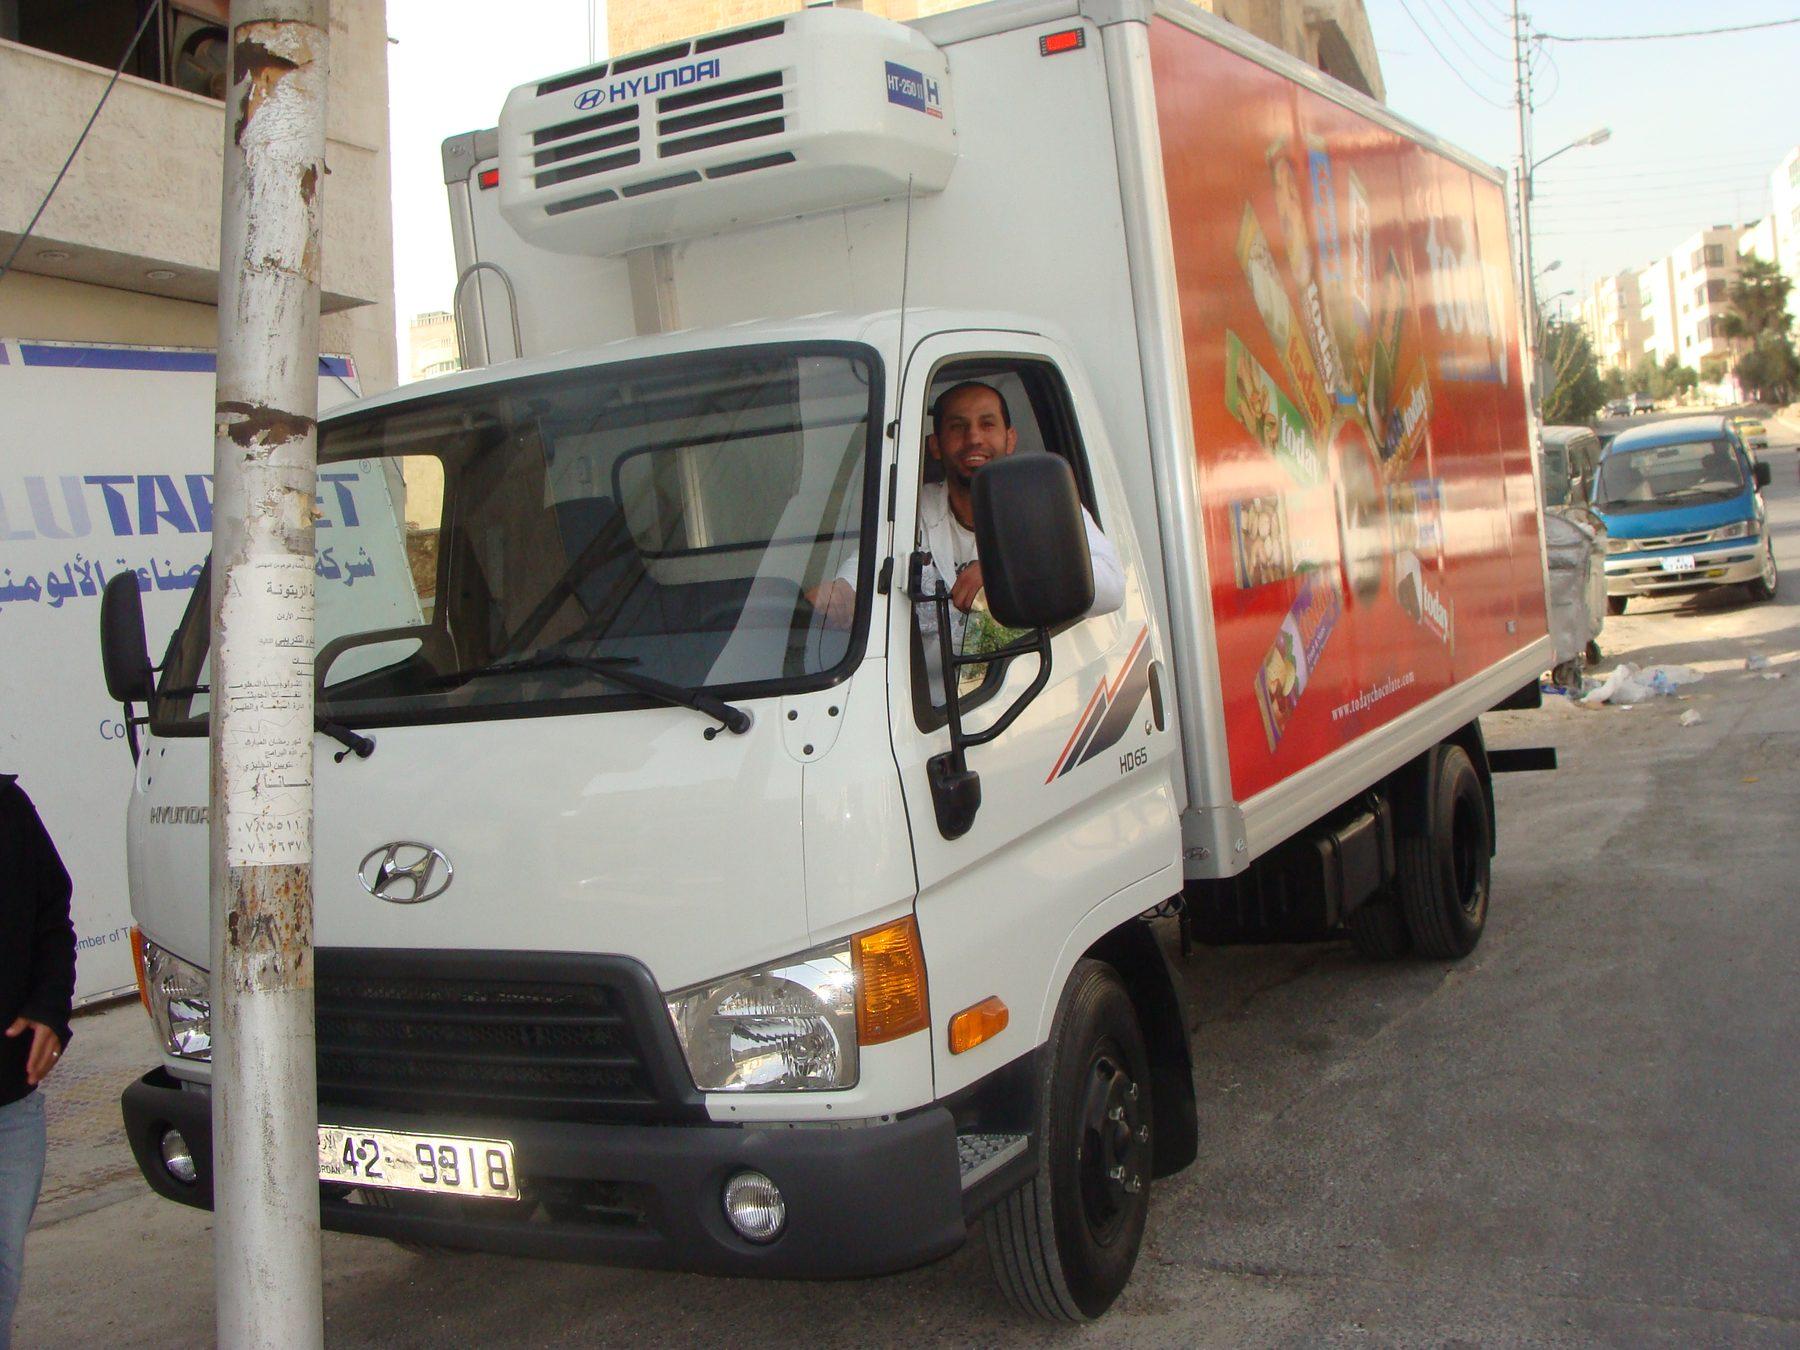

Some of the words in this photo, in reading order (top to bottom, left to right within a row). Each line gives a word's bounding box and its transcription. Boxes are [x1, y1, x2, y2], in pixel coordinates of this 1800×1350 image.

[610, 58, 720, 103] HYUNDAI
[1281, 412, 1319, 486] today
[0, 473, 360, 541] LUTAT
[0, 552, 106, 610] الألومن
[1423, 583, 1449, 645] today
[1331, 671, 1415, 721] www.todaychocolate.com
[244, 737, 267, 747] المبارك
[268, 738, 290, 746] رمضان
[1119, 747, 1148, 775] HD65
[150, 805, 210, 825] HYUNDA
[76, 934, 106, 951] mber
[109, 928, 120, 943] of
[319, 1163, 341, 1175] RDAN
[416, 1143, 510, 1191] 9918
